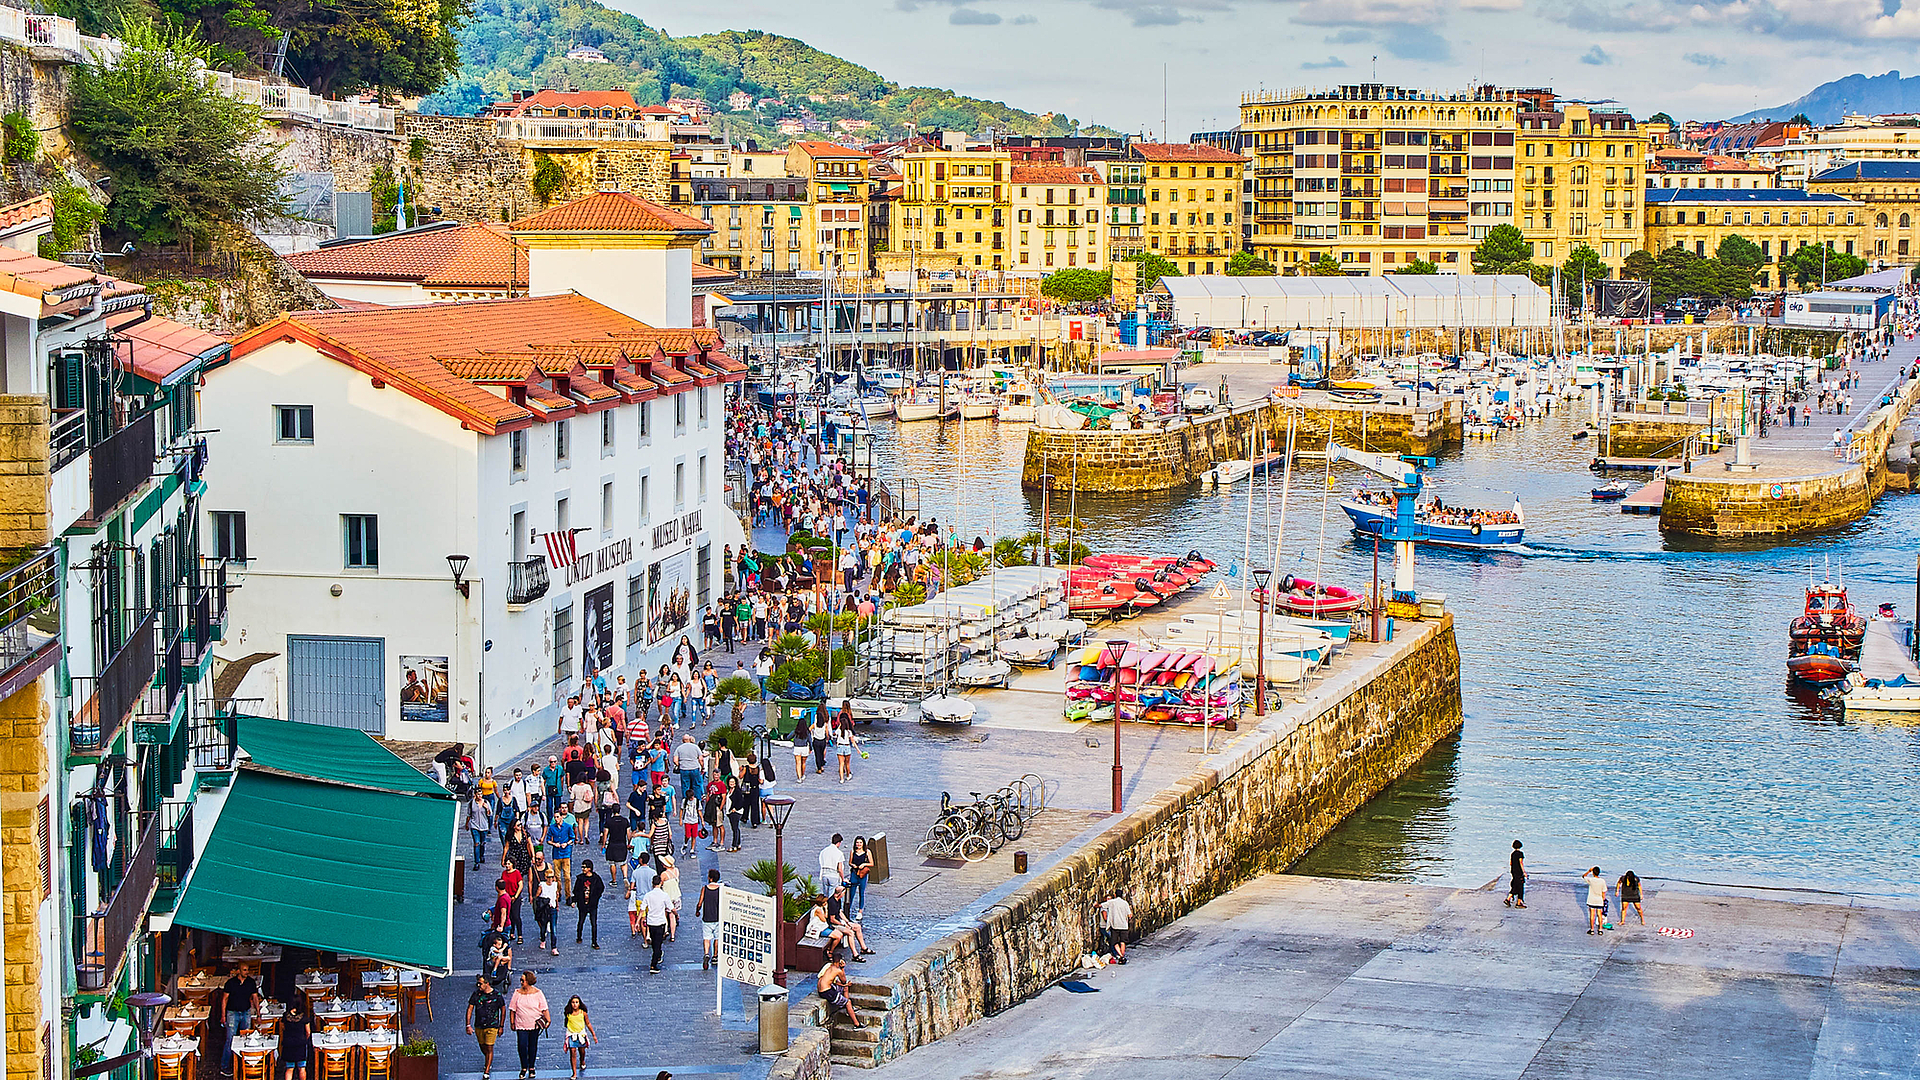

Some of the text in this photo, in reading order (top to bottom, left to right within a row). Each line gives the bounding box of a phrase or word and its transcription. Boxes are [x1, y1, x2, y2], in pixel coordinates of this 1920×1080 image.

[1789, 302, 1803, 313] ekp
[652, 509, 703, 550] MUSEO NAVAL
[565, 552, 593, 587] UNTZI
[596, 537, 632, 574] MUSEOA
